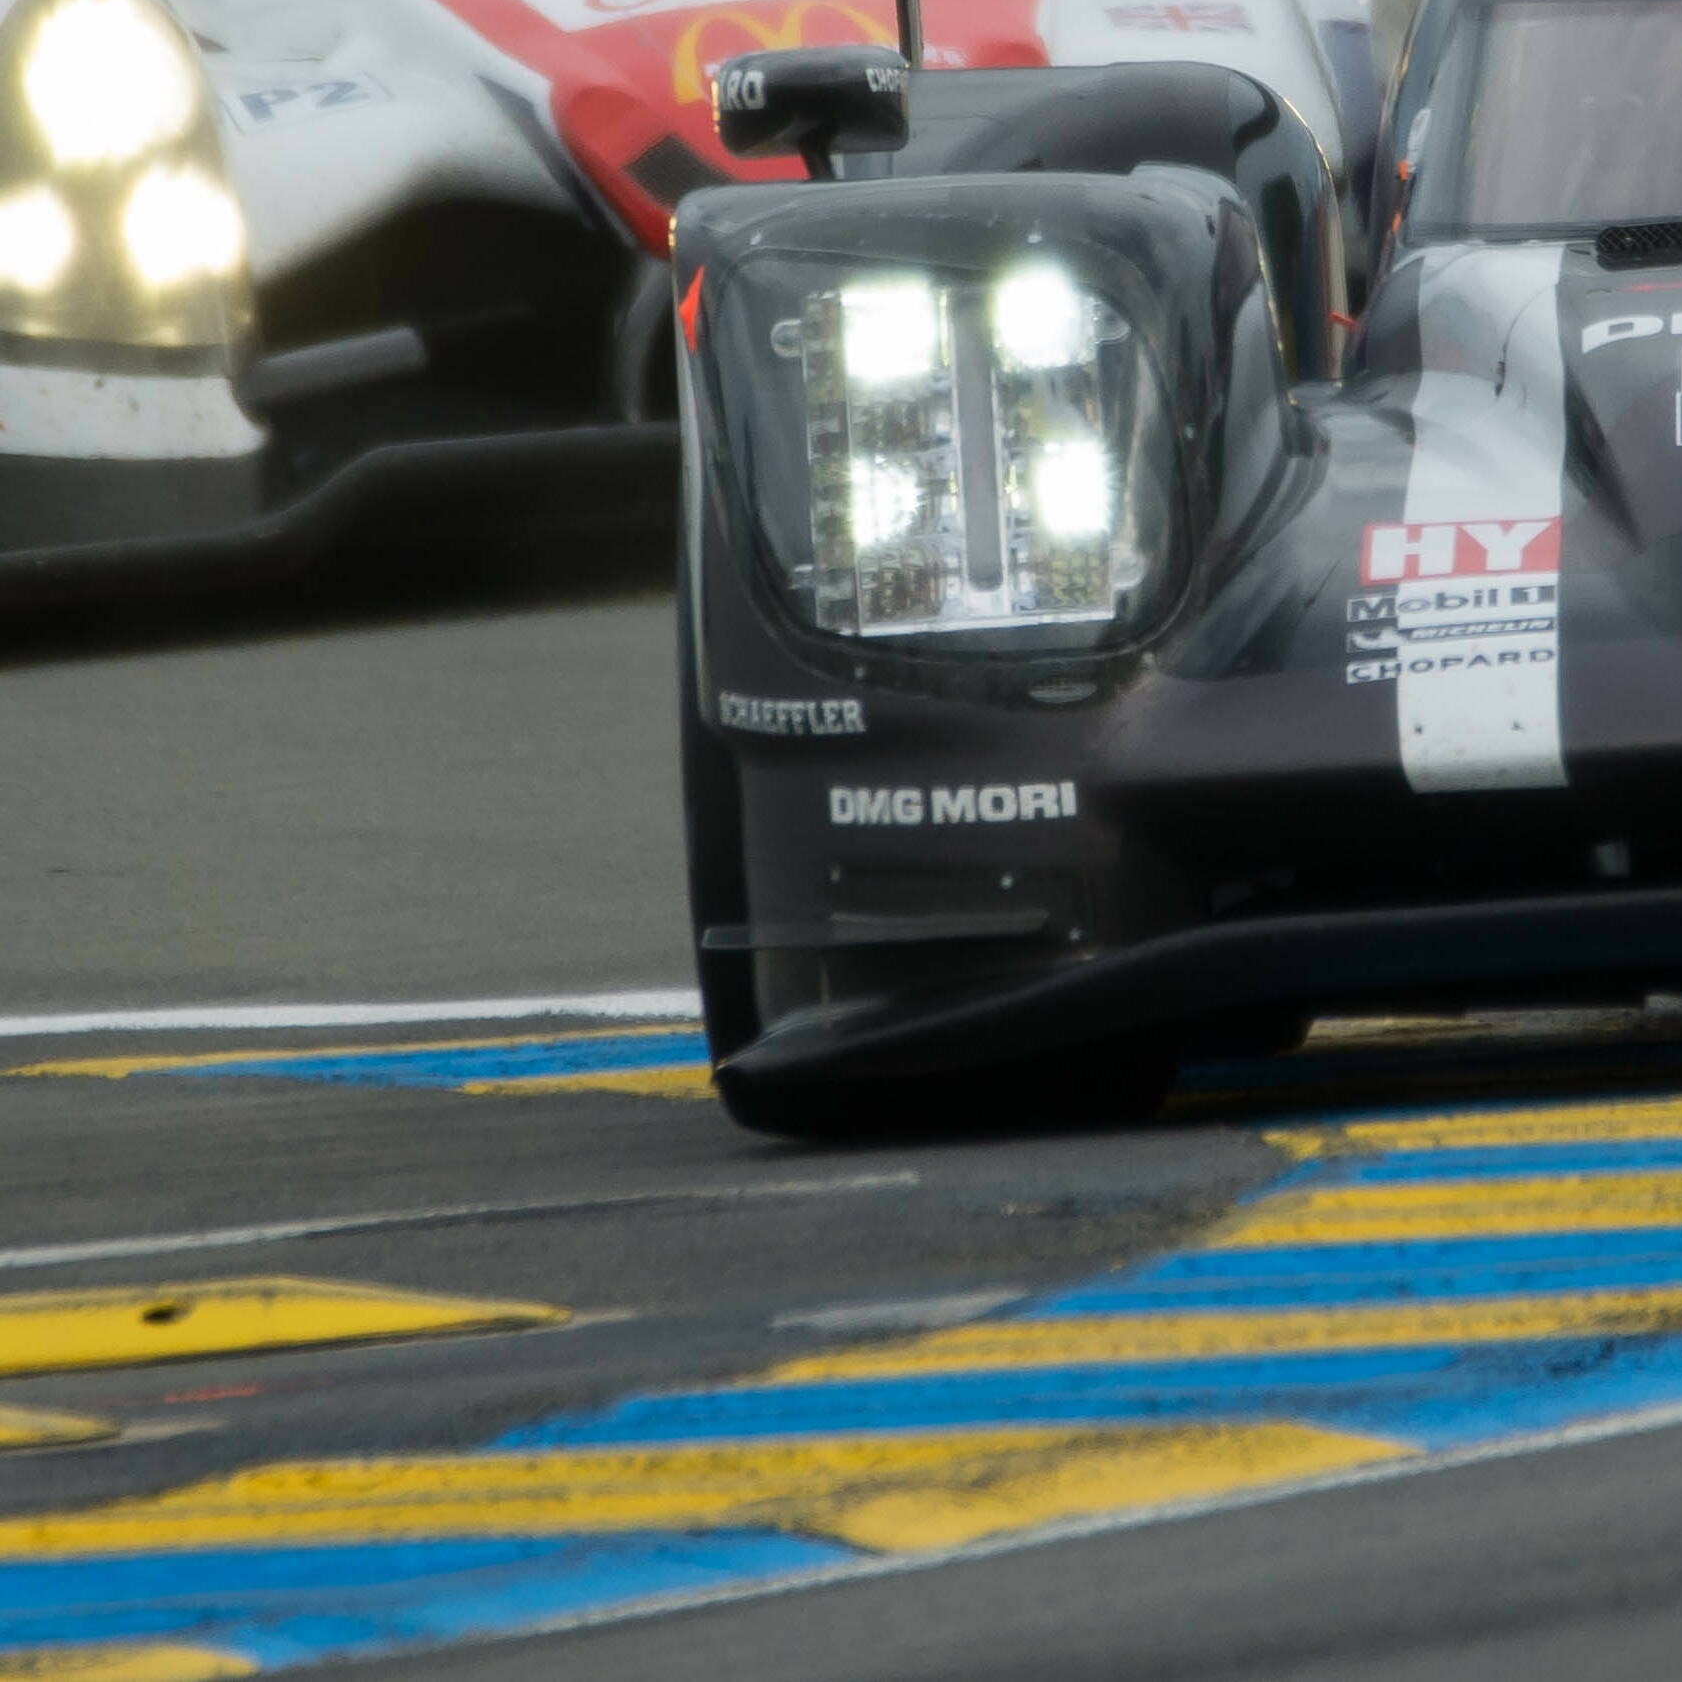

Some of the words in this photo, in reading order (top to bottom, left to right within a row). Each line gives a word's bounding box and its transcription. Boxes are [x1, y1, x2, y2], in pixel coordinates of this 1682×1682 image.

[240, 82, 371, 123] P2
[1369, 521, 1553, 581] HY
[1411, 620, 1551, 640] MICHELIN
[1351, 649, 1555, 681] CHOPARD
[829, 786, 924, 825] DMG
[931, 781, 1079, 824] MORI
